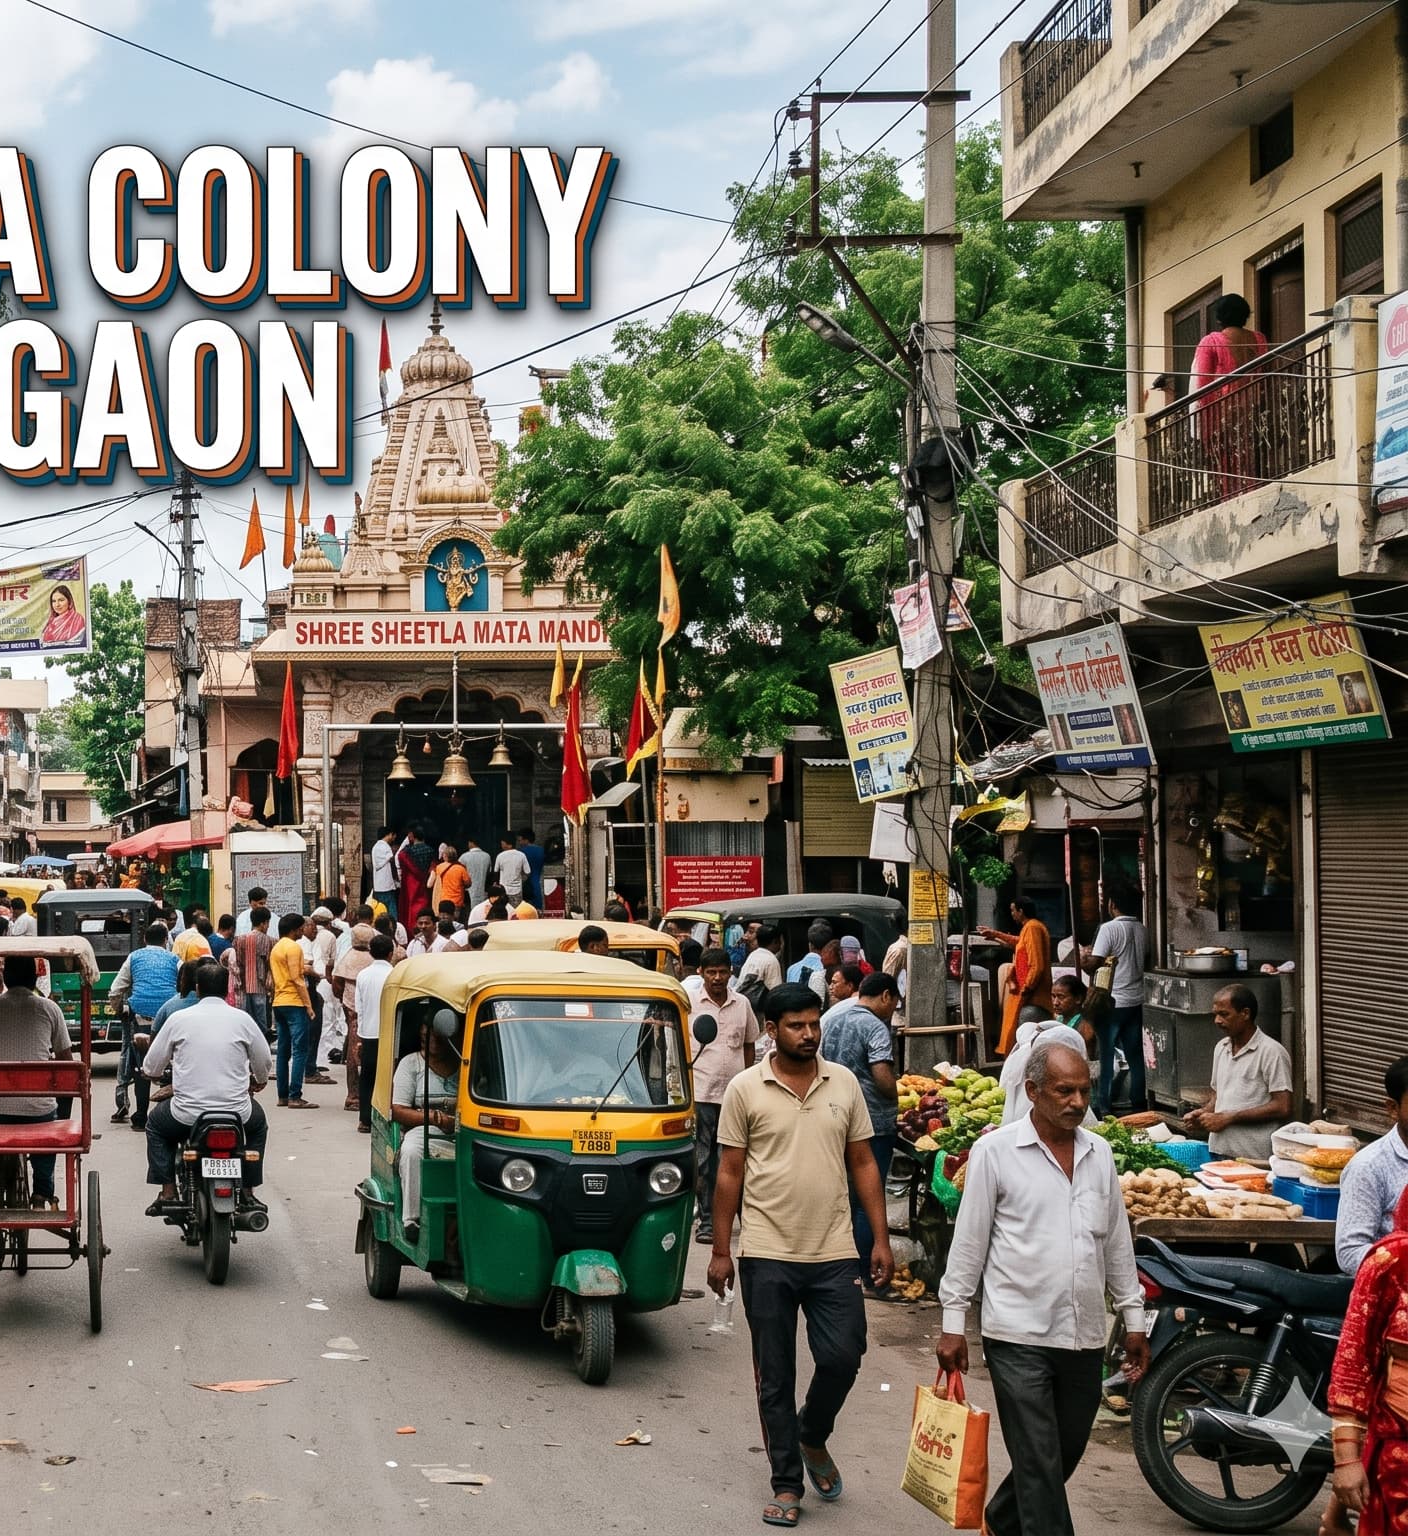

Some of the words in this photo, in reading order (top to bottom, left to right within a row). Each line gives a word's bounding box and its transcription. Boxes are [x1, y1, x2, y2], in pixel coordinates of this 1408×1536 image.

[295, 620, 364, 645] SHREE
[371, 620, 467, 645] SHEETLA
[473, 619, 532, 644] MATA
